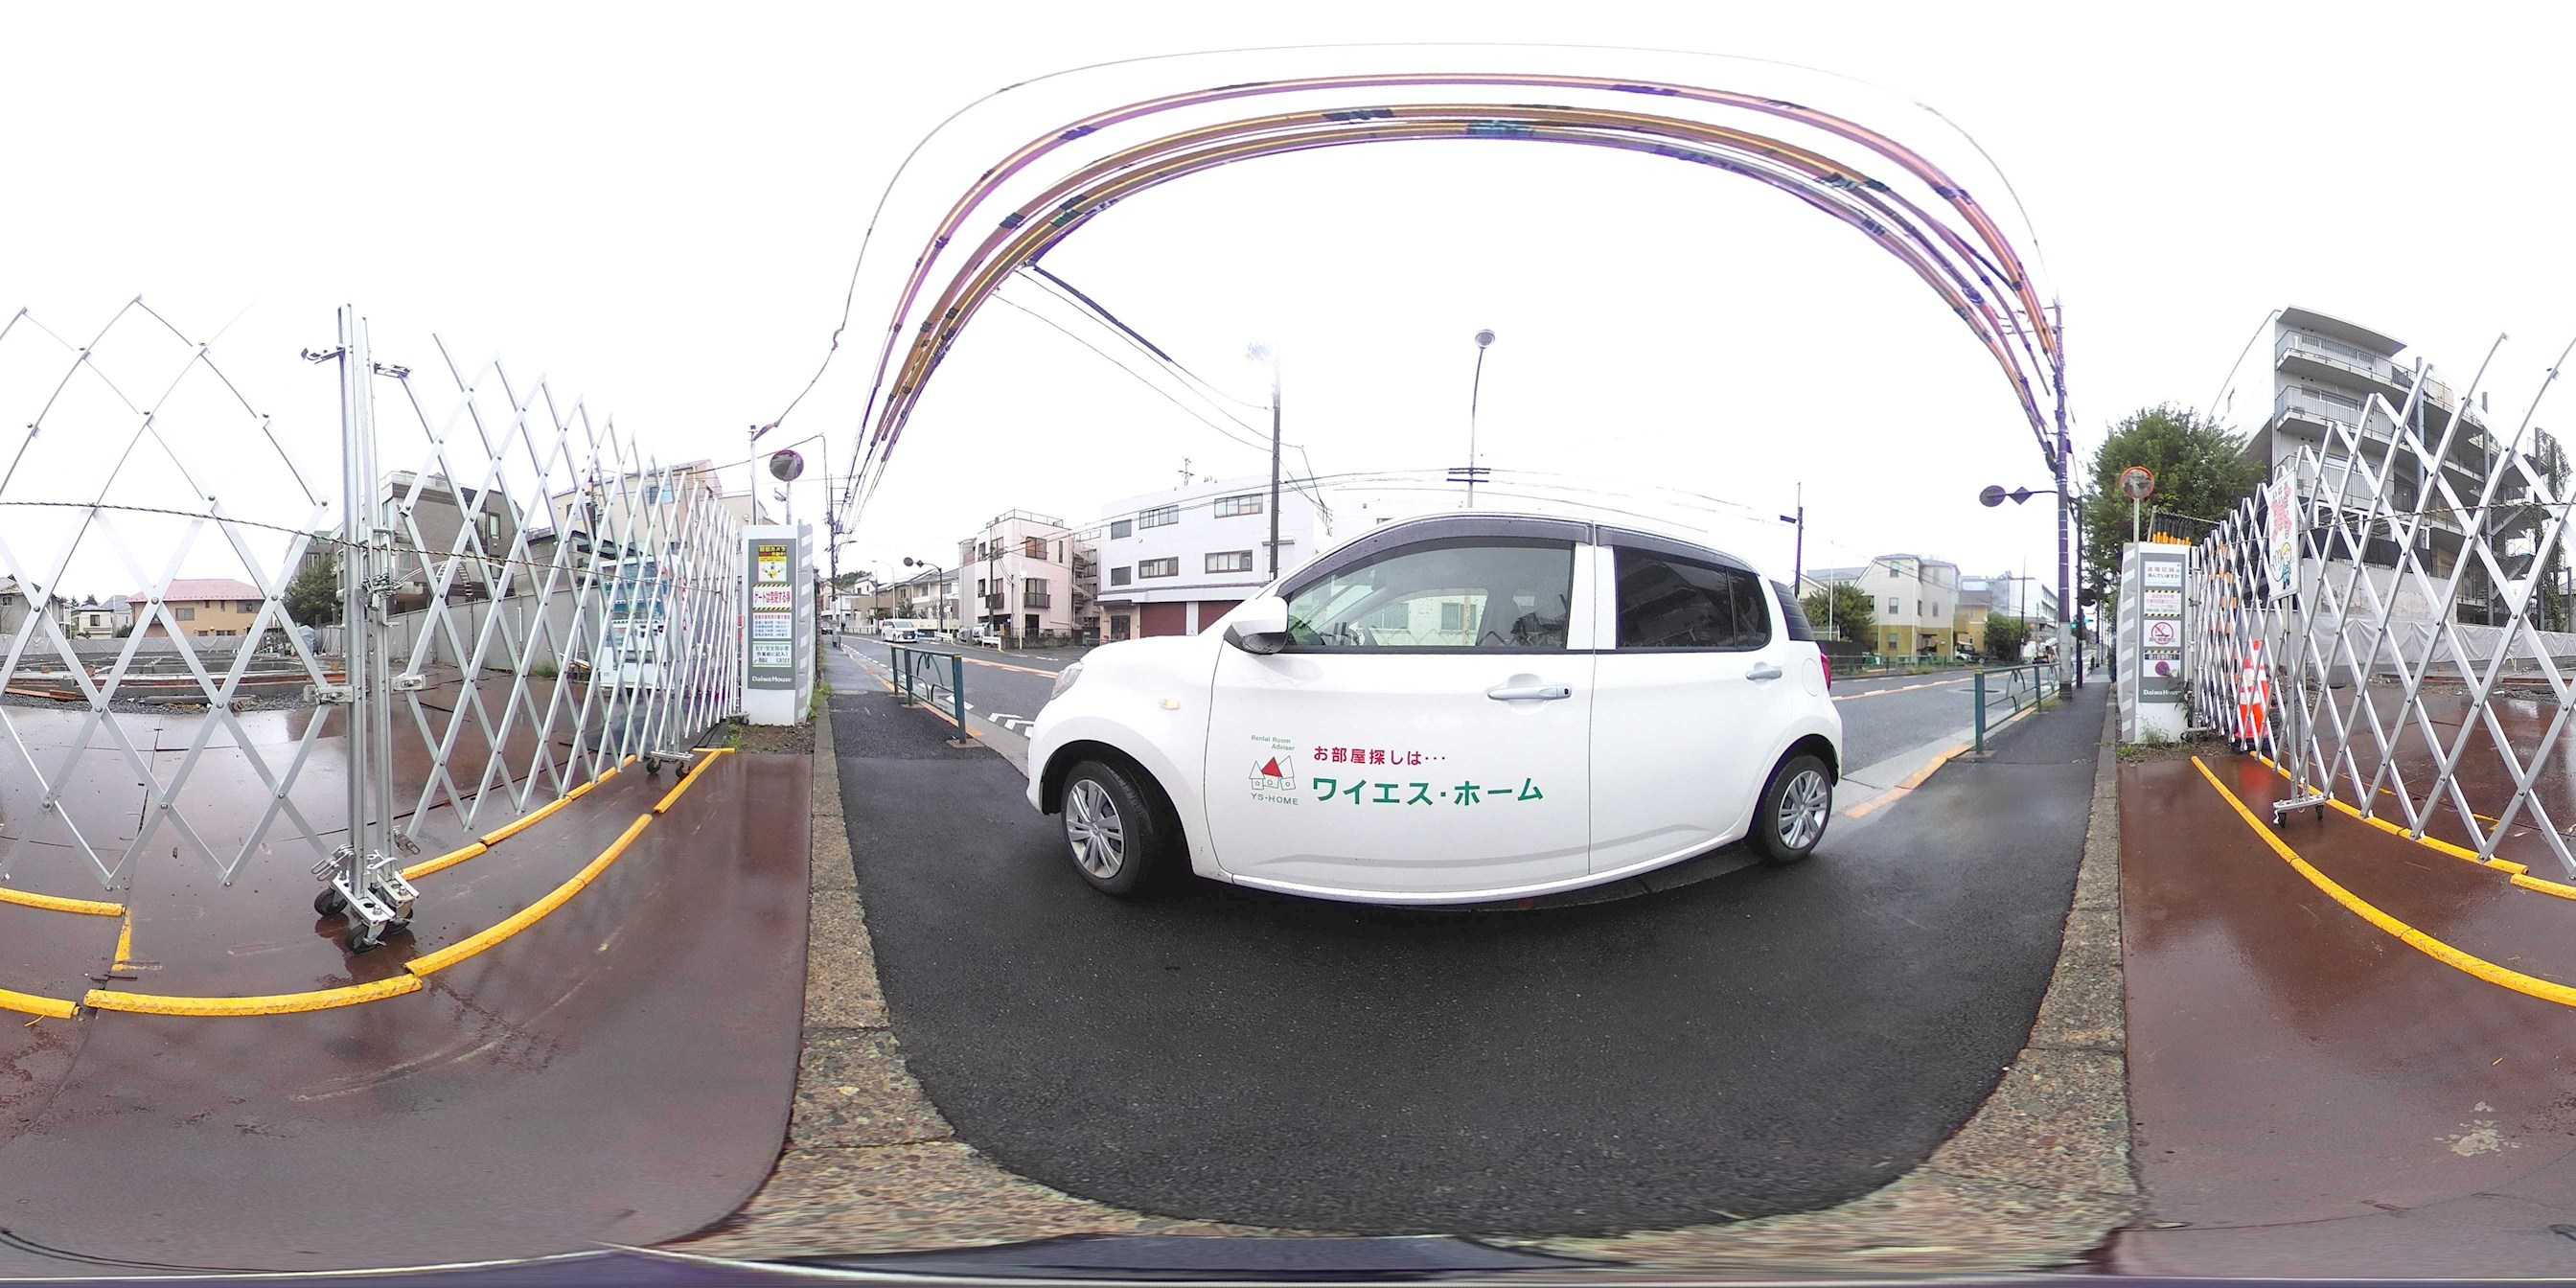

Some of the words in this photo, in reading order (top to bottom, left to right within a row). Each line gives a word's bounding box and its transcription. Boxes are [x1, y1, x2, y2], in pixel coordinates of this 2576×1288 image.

[1313, 777, 1544, 806] ワイエス・ホーム
